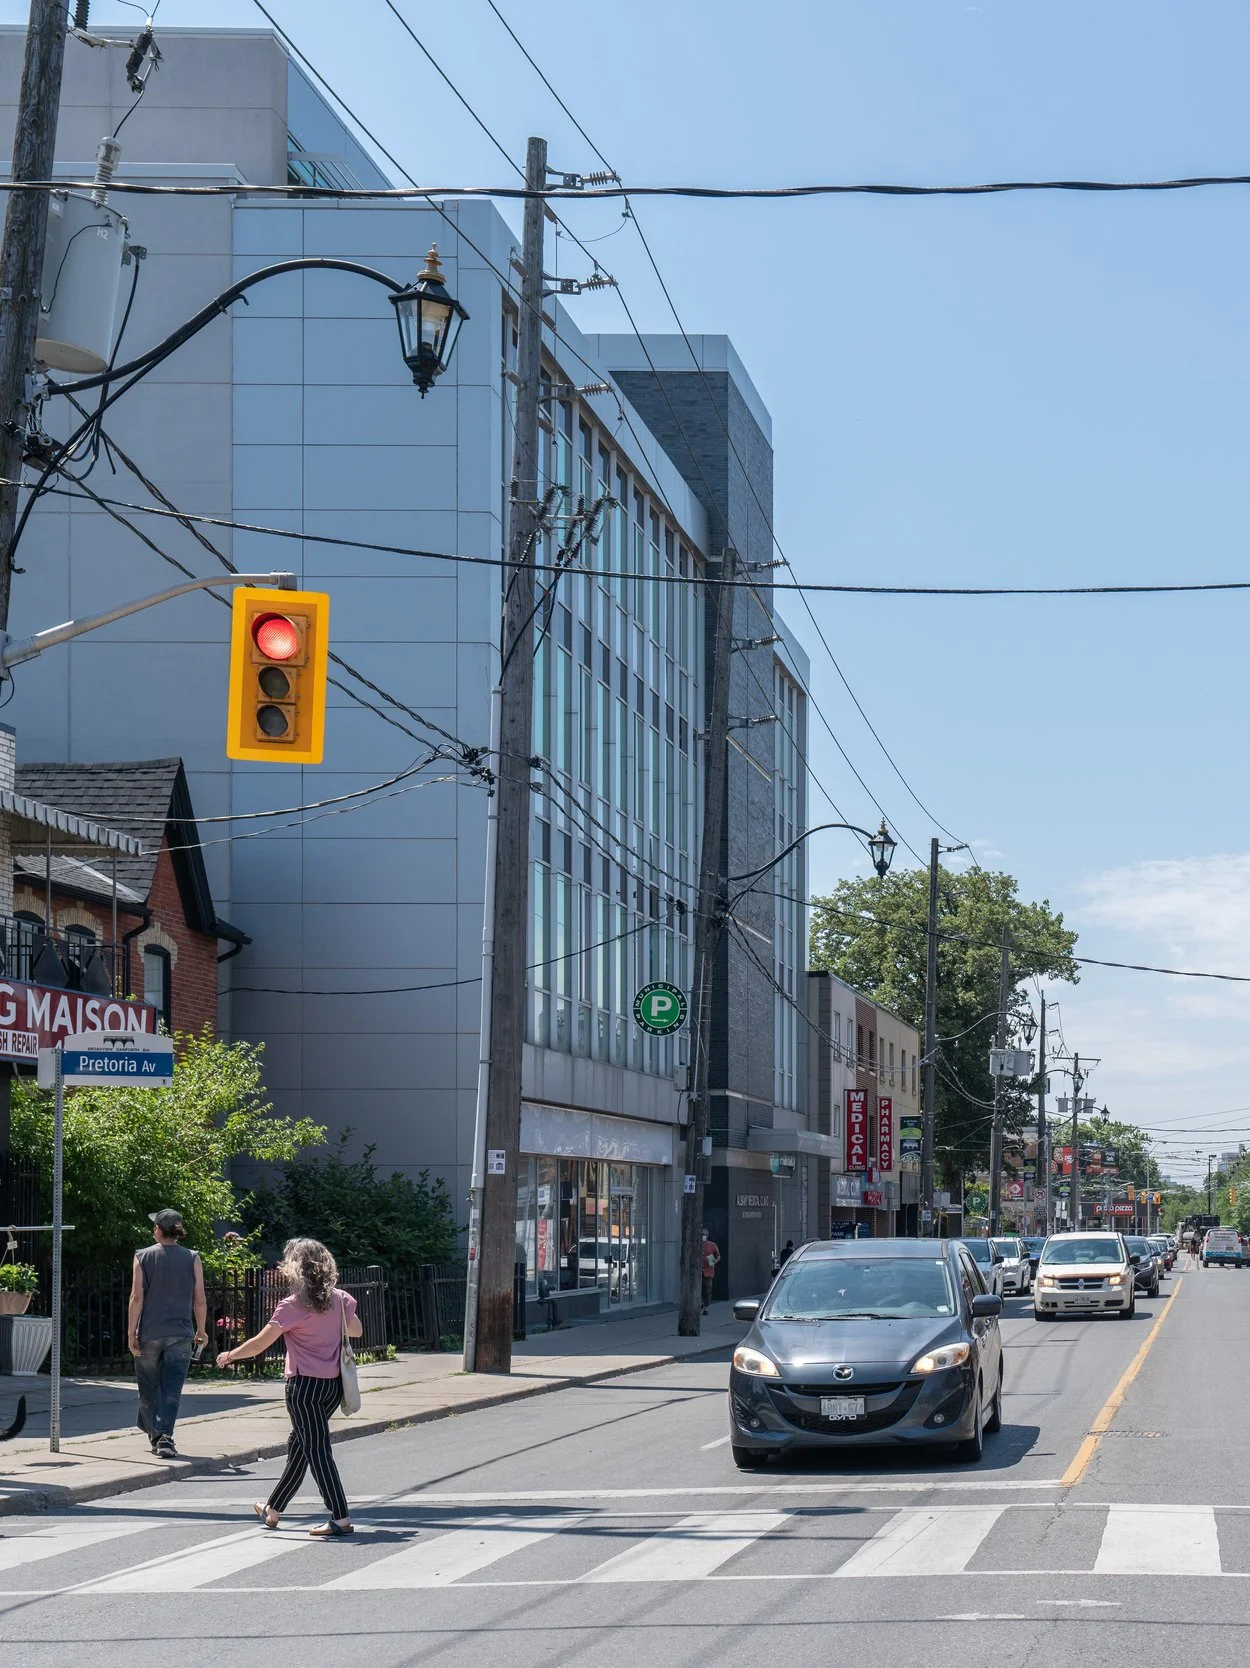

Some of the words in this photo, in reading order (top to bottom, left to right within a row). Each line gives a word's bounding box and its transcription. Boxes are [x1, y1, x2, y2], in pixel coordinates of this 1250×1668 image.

[635, 984, 686, 1007] MUNICIPAL
[651, 995, 672, 1017] P
[26, 988, 148, 1034] MAISON
[635, 1013, 685, 1035] PARKING
[12, 1032, 38, 1056] REPAIR
[79, 1055, 137, 1073] Pretoria
[141, 1060, 156, 1073] Av
[850, 1091, 865, 1165] MEDICAL
[881, 1100, 890, 1169] PHARMACY
[973, 1197, 981, 1205] P
[1114, 1205, 1133, 1213] pizza
